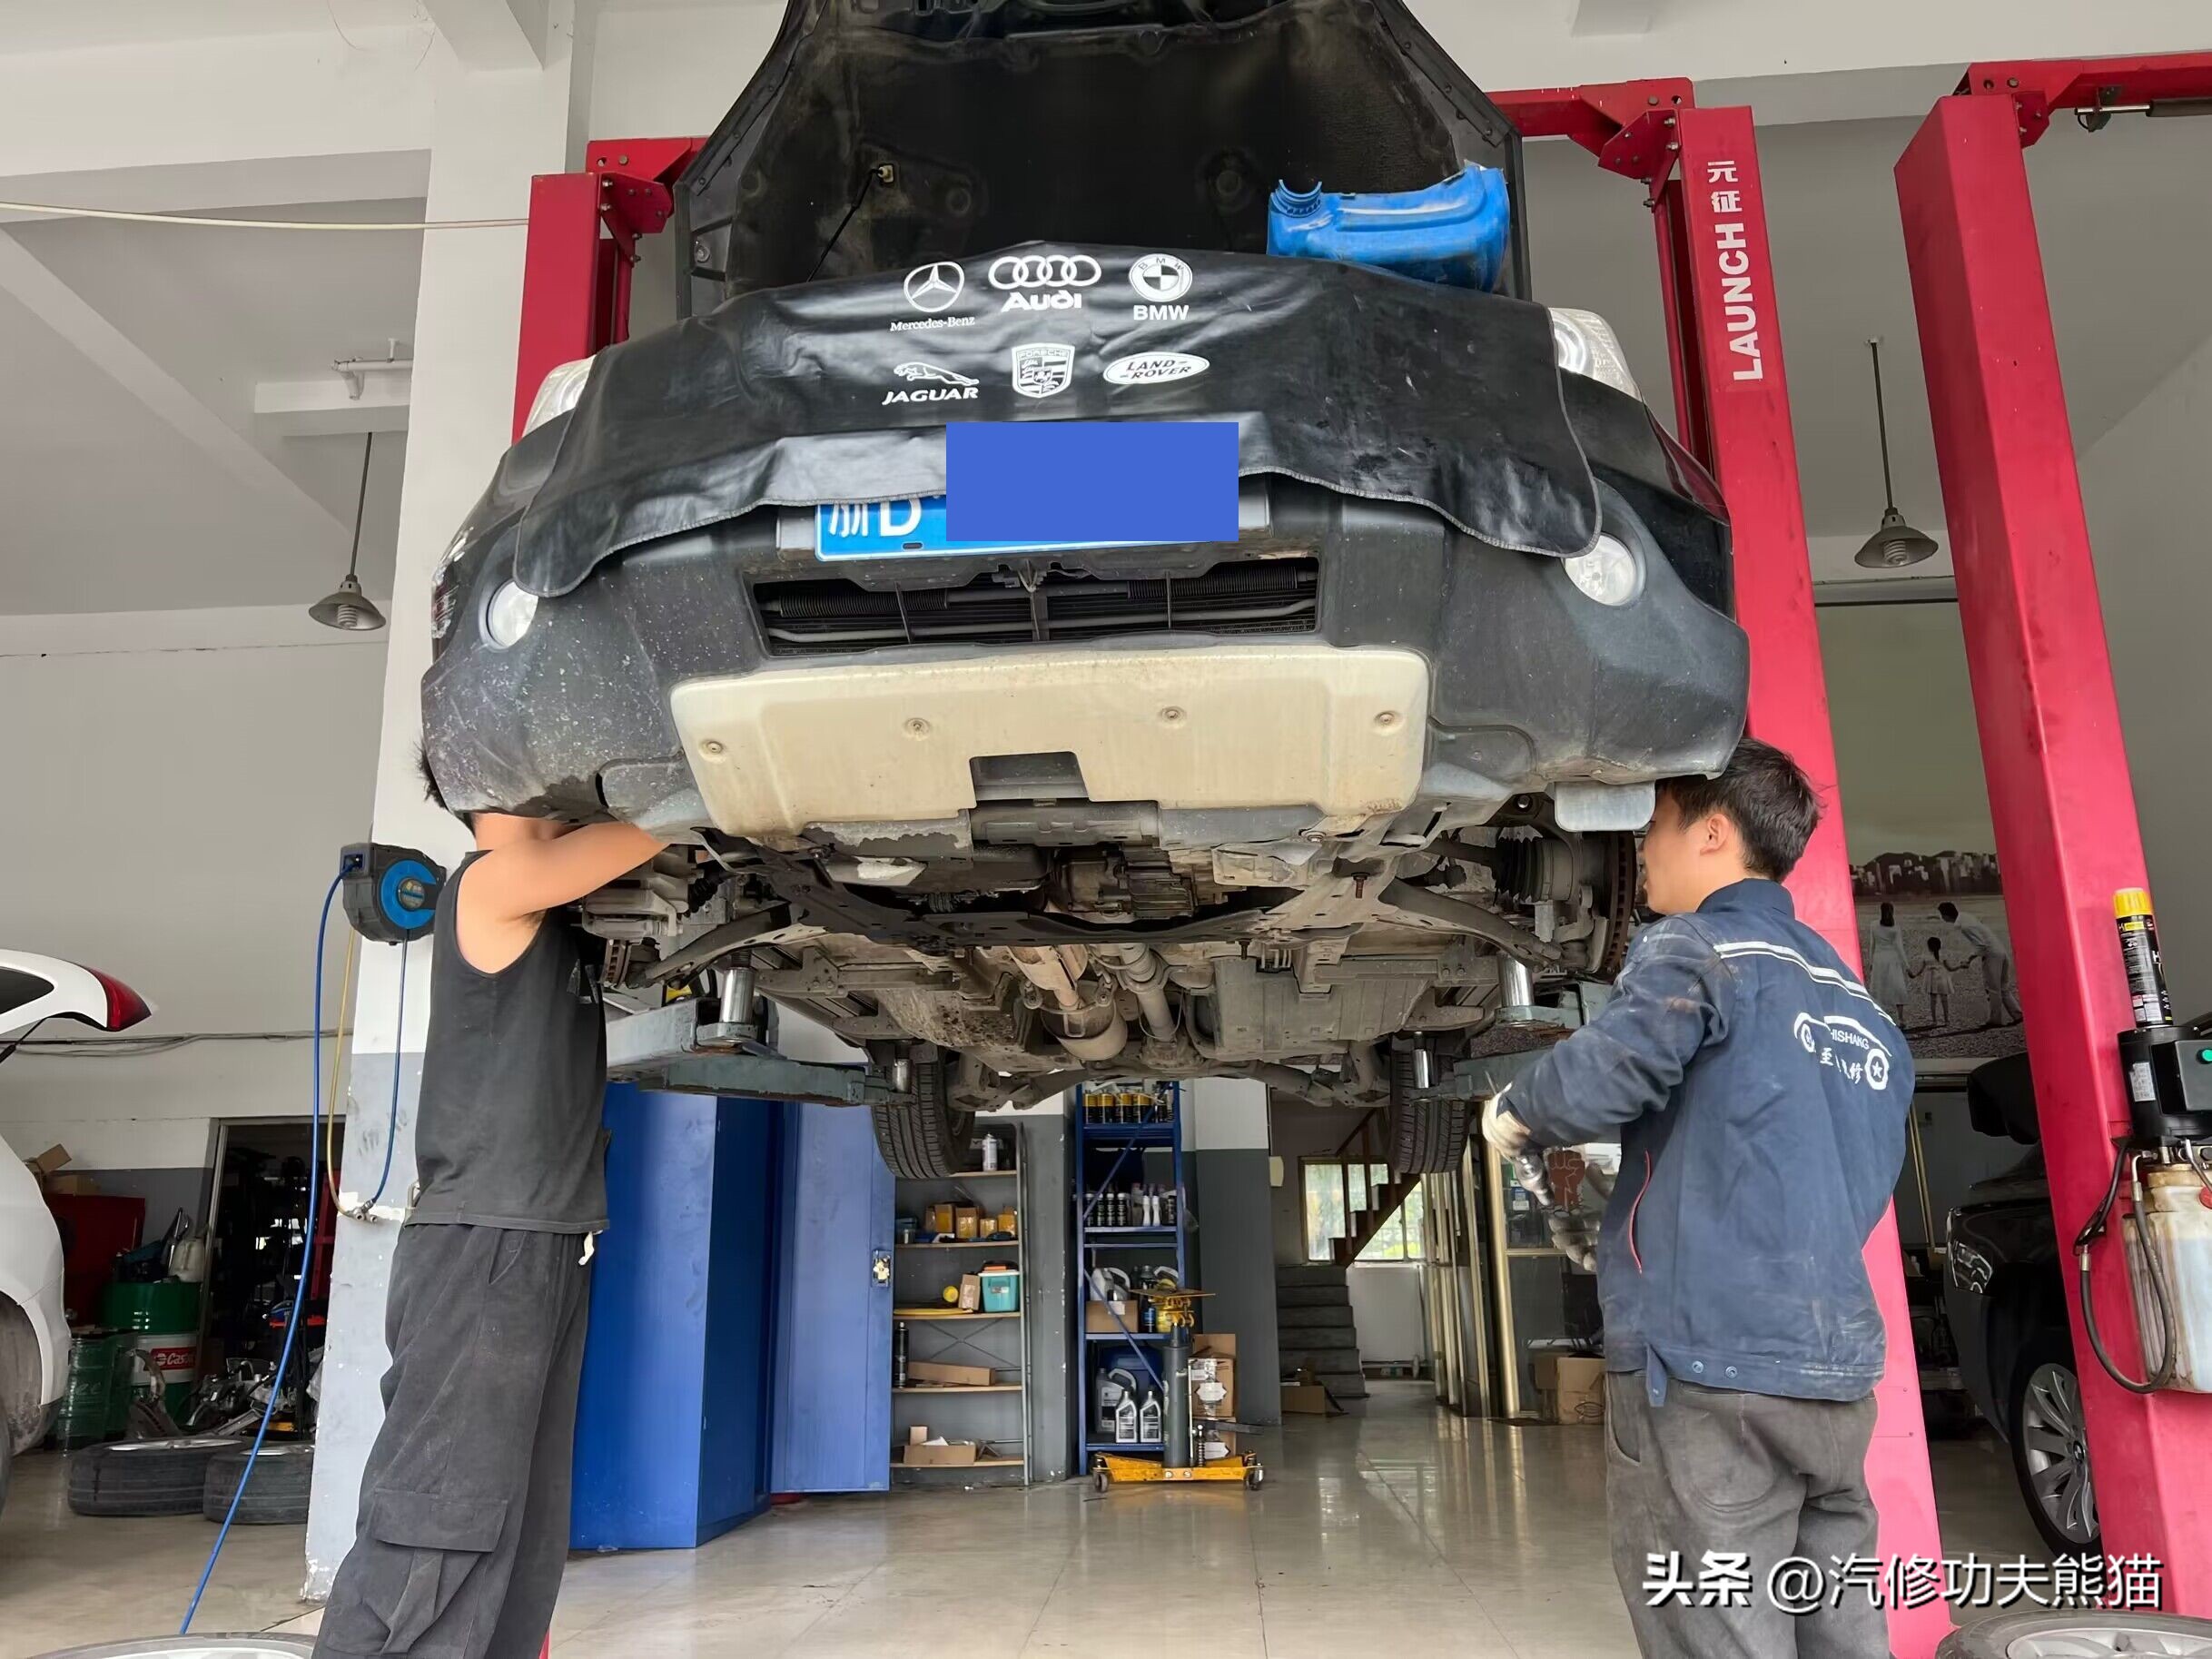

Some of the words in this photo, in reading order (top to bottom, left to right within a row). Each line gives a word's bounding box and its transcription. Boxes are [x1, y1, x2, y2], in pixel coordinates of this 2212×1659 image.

[1706, 160, 1743, 213] 元征
[1001, 290, 1082, 312] Audi
[1714, 222, 1763, 381] LAUNCH
[1133, 304, 1190, 321] BMW
[890, 316, 976, 331] Mercedes-Benz
[882, 387, 979, 406] JAGUAR
